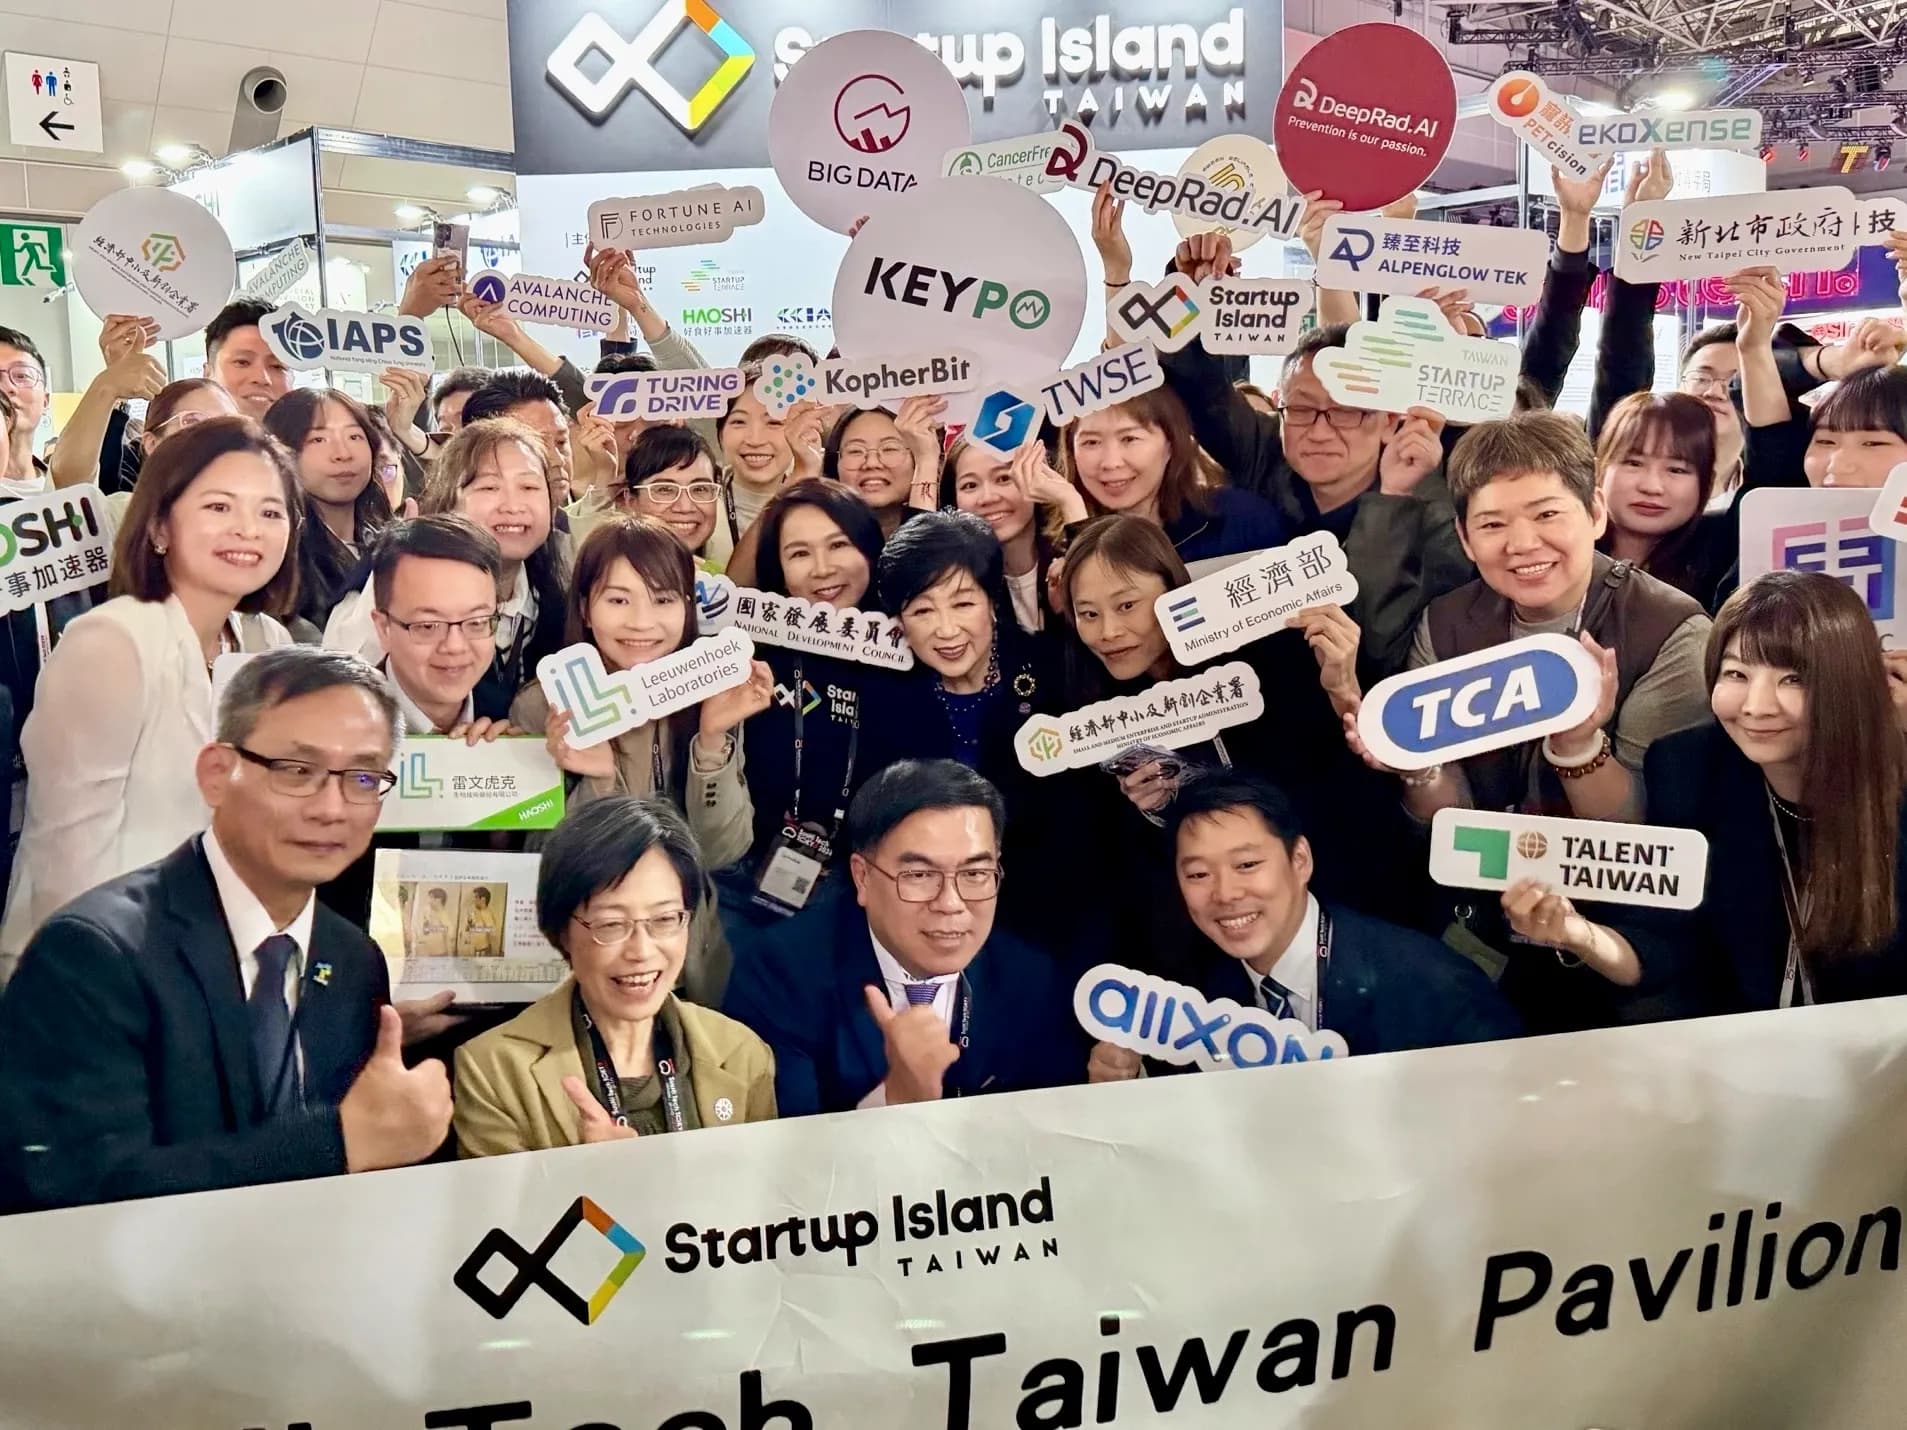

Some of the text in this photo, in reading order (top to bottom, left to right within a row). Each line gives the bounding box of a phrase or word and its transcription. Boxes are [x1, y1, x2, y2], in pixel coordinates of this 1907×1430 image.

[1041, 8, 1245, 74] Island
[1043, 81, 1245, 114] TAIWAN
[1319, 96, 1439, 138] DeepRad.AI
[1288, 115, 1428, 157] Prevention is our passion.
[1523, 118, 1587, 175] PETcision
[987, 145, 1052, 169] CancerFre
[808, 160, 918, 193] BIG DATA
[629, 199, 753, 223] FORTUNE AI
[1088, 156, 1300, 235] DeepRad.AI
[631, 221, 721, 238] TECHNOLOGIES
[1676, 207, 1844, 249] 新北市政府
[1679, 243, 1845, 262] New Taipei City Government
[264, 258, 306, 298] MPUTING
[1377, 259, 1528, 285] ALPENGLOW TEK
[508, 300, 612, 326] COMPUTING
[1209, 286, 1300, 311] Startup
[683, 308, 752, 324] HAOSHI
[1215, 308, 1288, 329] Island
[326, 318, 425, 357] IAPS
[1214, 333, 1286, 342] TAIWAN
[1463, 350, 1509, 366] TAIWAN
[647, 374, 738, 395] TURING
[826, 356, 970, 398] KopherBit
[1041, 347, 1152, 416] TWSE
[1418, 365, 1505, 391] STARTUP
[648, 394, 722, 414] DRIVE
[1416, 384, 1504, 412] TERRACE
[0, 546, 109, 598] 事加速器
[1223, 544, 1333, 609] 經濟部
[1184, 581, 1343, 653] Ministry of Economic Affairs
[734, 620, 905, 664] NATIONAL DEVELOPMENT COUNCIL
[641, 639, 742, 690] Leeuwenhoek
[648, 659, 740, 708] Laboratories
[831, 699, 855, 717] Isla
[1412, 664, 1541, 741] TCA
[452, 775, 517, 791] 雷文虎克
[518, 799, 554, 821] HAOSHI
[1562, 836, 1675, 868] TALENT
[1559, 864, 1680, 897] TAIWAN
[666, 1177, 1053, 1274] Startup Island
[898, 1238, 1058, 1276] TAIWAN
[912, 1304, 1396, 1430] Taiwan
[1474, 1202, 1904, 1353] Pavilion
